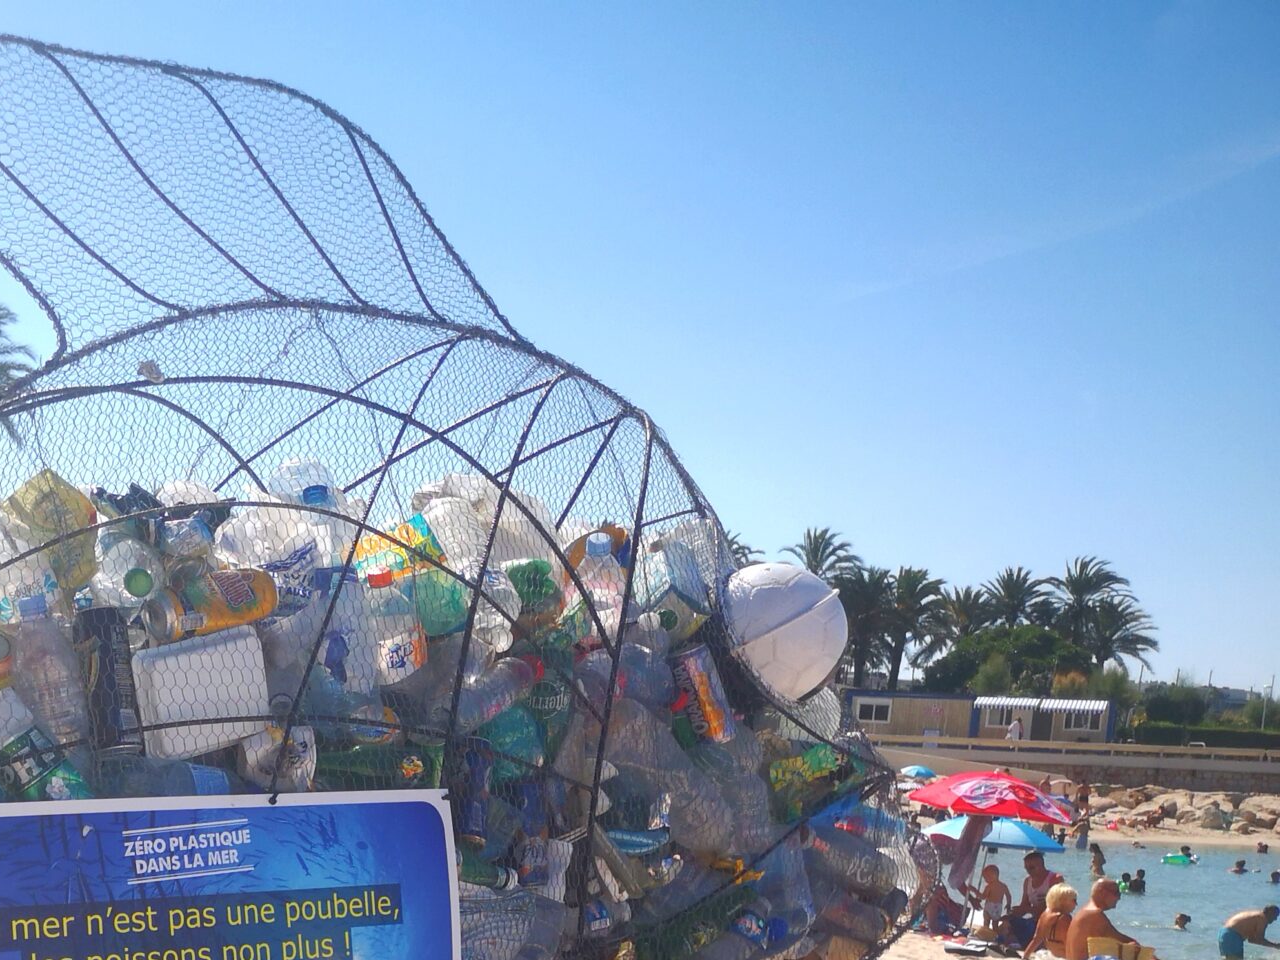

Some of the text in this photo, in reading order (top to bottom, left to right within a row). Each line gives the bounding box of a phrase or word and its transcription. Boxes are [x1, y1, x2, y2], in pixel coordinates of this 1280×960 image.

[123, 828, 251, 857] ZÉRO PLASTIQUE
[134, 848, 239, 874] DANS LA MER
[10, 915, 75, 941] mer
[86, 905, 158, 935] n'est
[168, 906, 216, 936] pas
[226, 902, 275, 926] une
[284, 889, 399, 928] poubelle,
